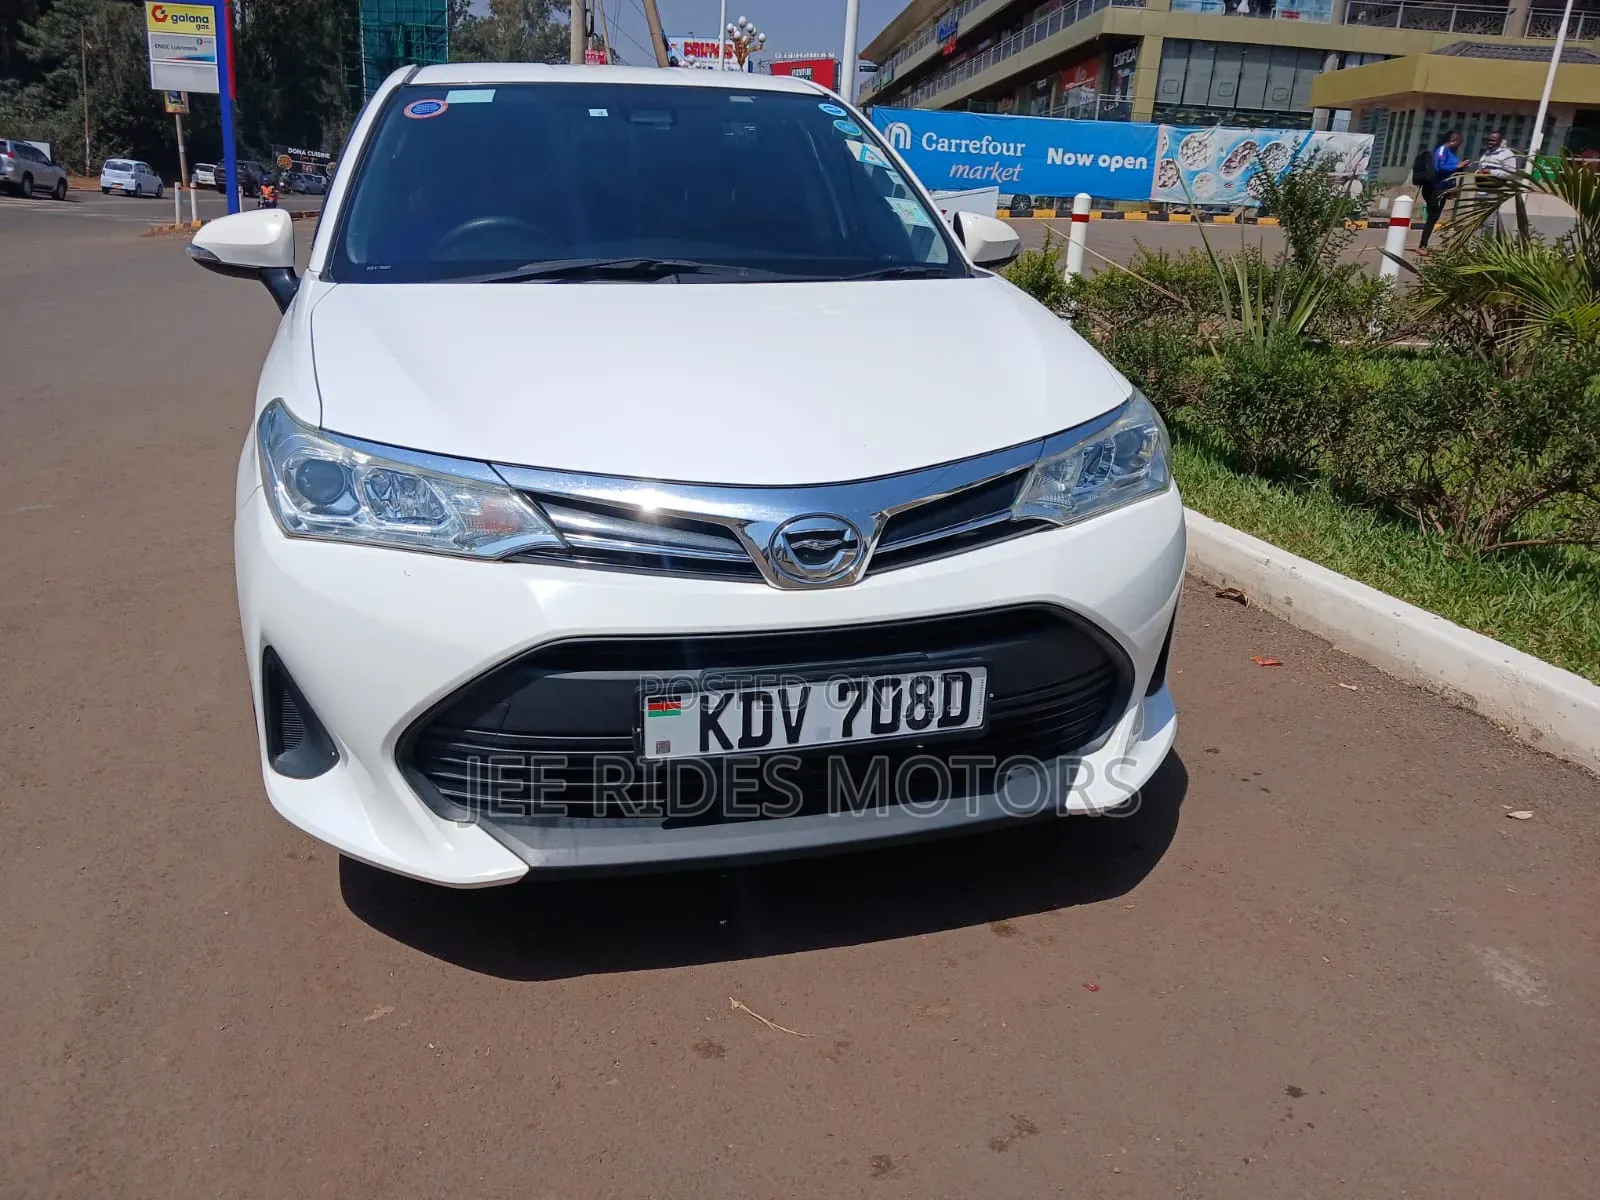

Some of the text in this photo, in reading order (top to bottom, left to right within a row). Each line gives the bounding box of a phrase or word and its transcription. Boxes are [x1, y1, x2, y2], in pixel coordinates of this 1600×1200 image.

[171, 13, 209, 24] galana
[288, 147, 306, 156] DONA
[307, 150, 331, 159] CUISINE
[922, 132, 1026, 156] Carrefour
[1047, 147, 1148, 172] Now open
[950, 162, 1023, 183] market
[700, 686, 811, 752] KDV
[838, 671, 972, 737] 708D
